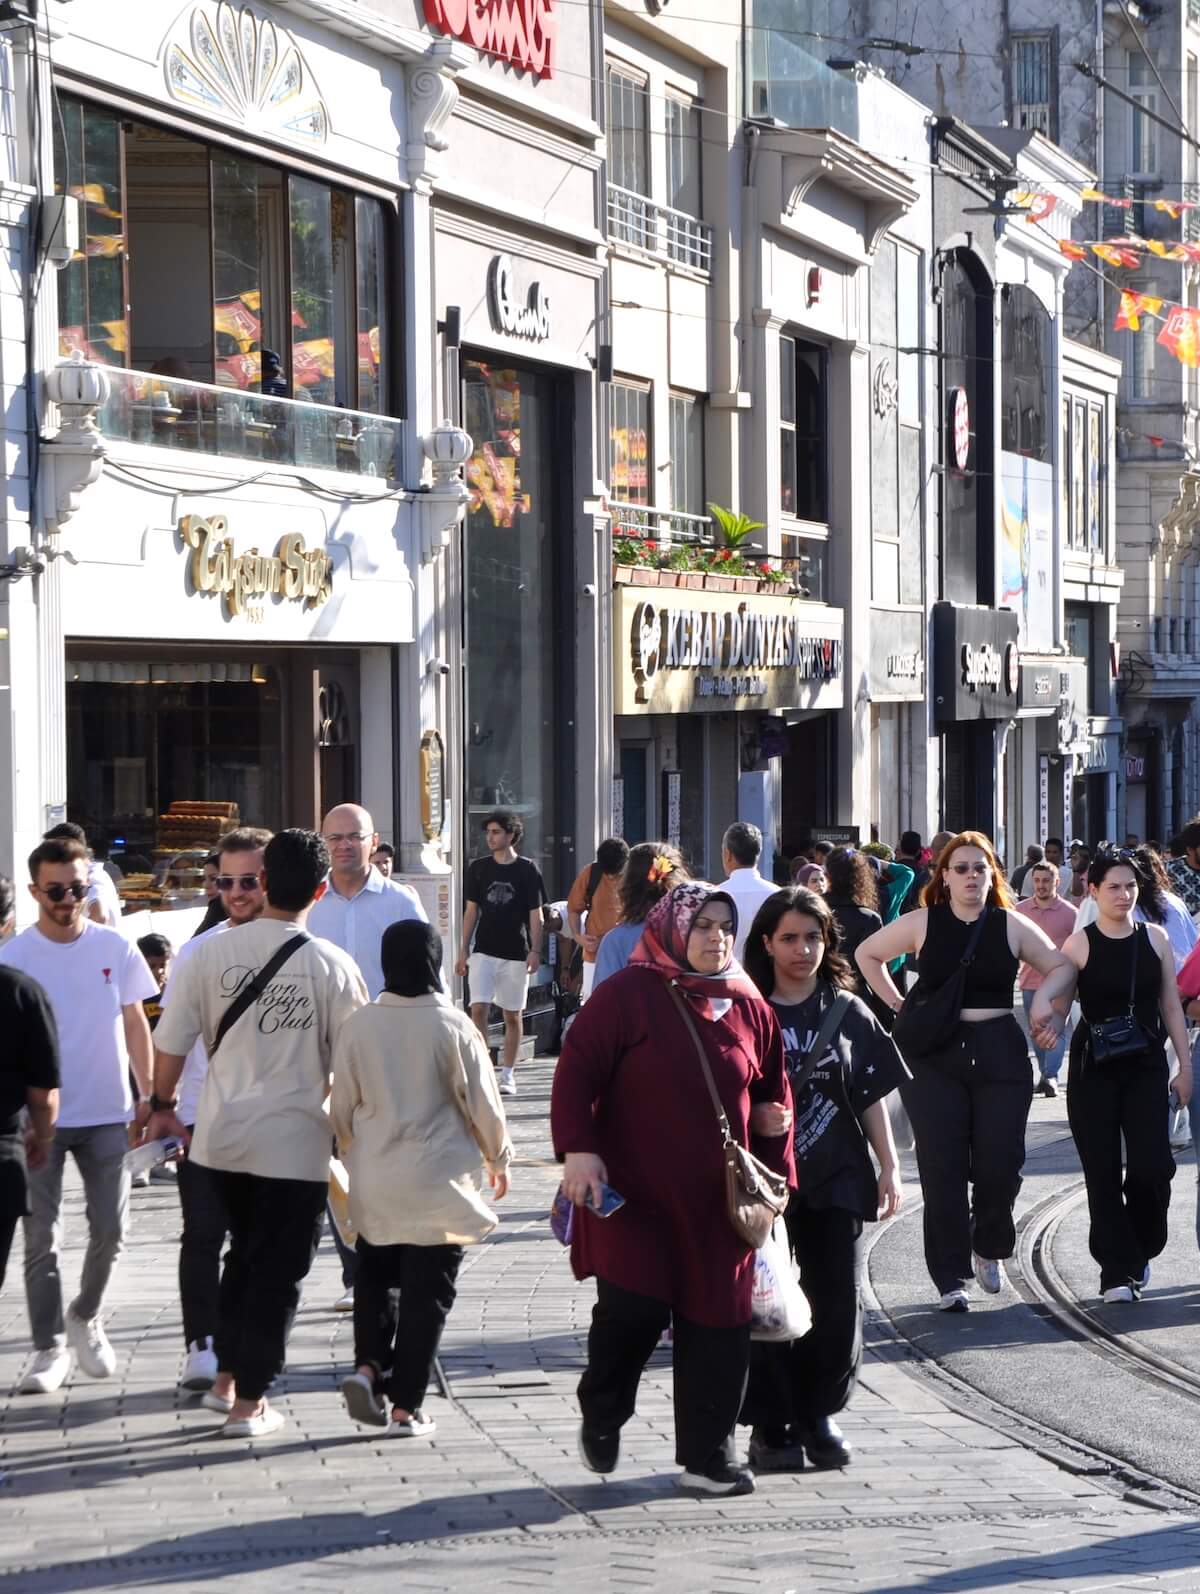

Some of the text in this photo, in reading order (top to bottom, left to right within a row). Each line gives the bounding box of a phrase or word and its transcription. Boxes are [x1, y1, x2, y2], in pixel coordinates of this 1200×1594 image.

[182, 514, 281, 616] Taksim
[661, 608, 727, 668] KEBAP
[220, 964, 300, 998] Dwn
[258, 1000, 316, 1034] Club
